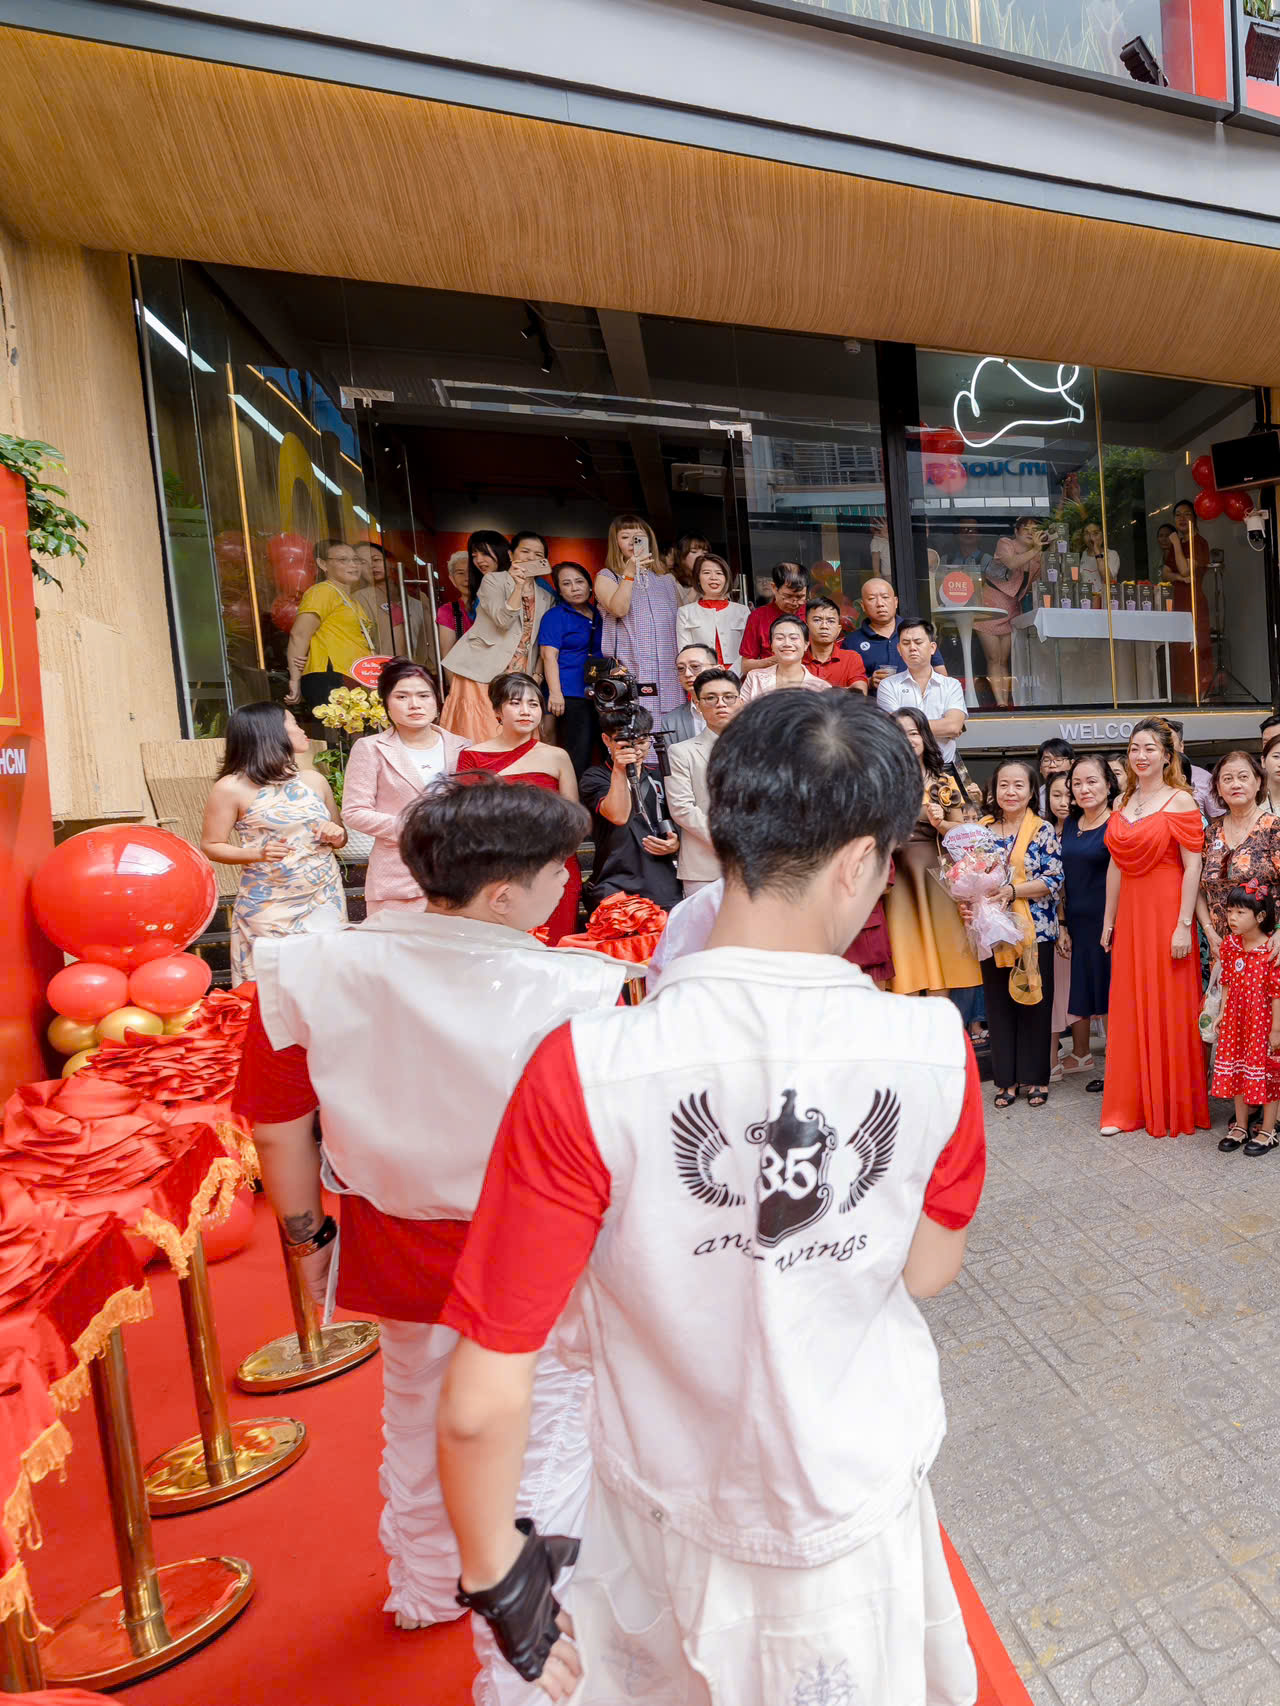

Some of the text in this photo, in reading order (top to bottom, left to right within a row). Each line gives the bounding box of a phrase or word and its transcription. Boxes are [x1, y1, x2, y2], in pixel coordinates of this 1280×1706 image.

[1060, 721, 1136, 740] WELCO
[0, 748, 26, 775] HCM
[758, 1141, 822, 1204] 35
[774, 1233, 868, 1273] wings
